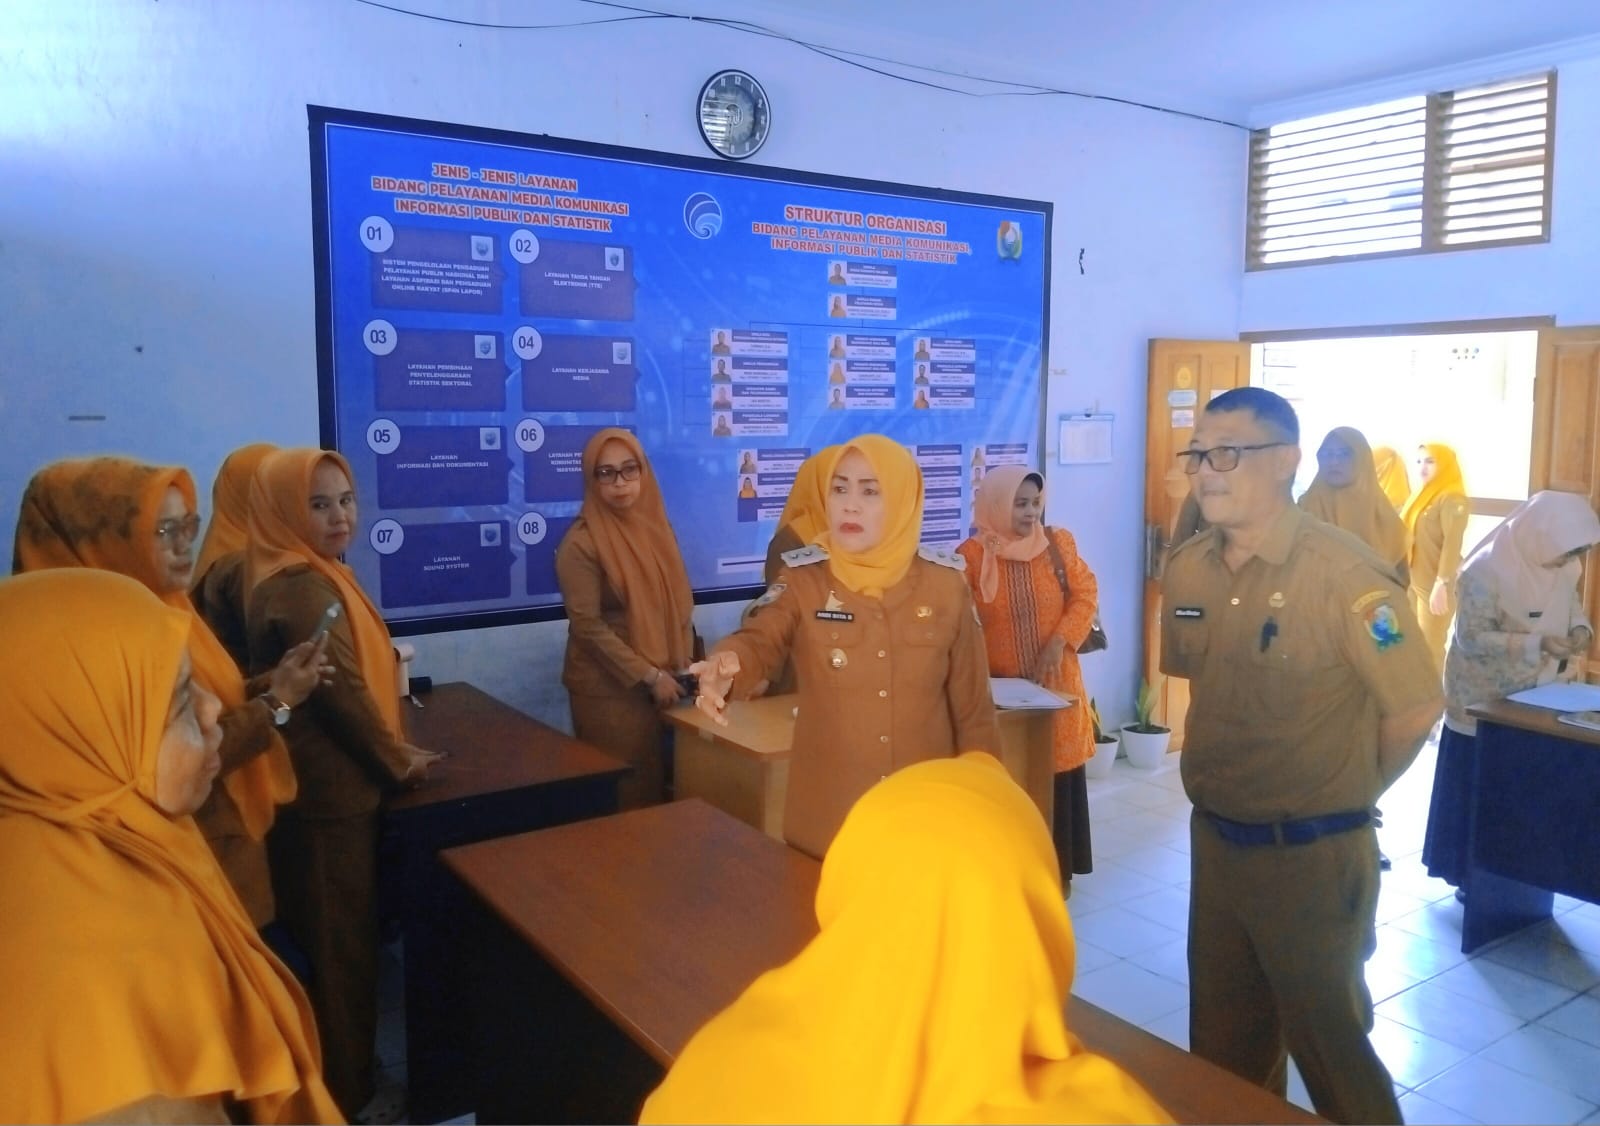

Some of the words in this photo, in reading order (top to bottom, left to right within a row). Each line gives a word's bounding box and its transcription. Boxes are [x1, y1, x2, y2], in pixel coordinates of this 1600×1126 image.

[432, 163, 469, 179] JENIS
[481, 169, 516, 185] JENIS
[519, 174, 577, 191] LAYANAN
[372, 177, 427, 193] BIDANG
[429, 182, 508, 202] PELAYANAN
[511, 190, 552, 207] MEDIA
[555, 196, 629, 216] KOMUNIKASI
[395, 199, 470, 217] INFORMASI
[474, 206, 519, 222] PUBLIK
[523, 211, 550, 225] DAN
[552, 214, 612, 232] STATISTIK
[785, 205, 863, 227] STRUKTUR
[867, 214, 947, 236] ORGANISASI
[366, 226, 382, 241] 01
[752, 223, 798, 238] BIDANG
[801, 228, 867, 244] PELAYANAN
[870, 233, 903, 247] MEDIA
[515, 239, 532, 253] 02
[771, 238, 835, 255] INFORMASI
[839, 244, 880, 258] PUBLIK
[882, 248, 903, 260] DAN
[905, 250, 958, 265] STATISTIK
[370, 330, 387, 344] 03
[518, 336, 535, 349] 04
[373, 429, 391, 443] 05
[520, 428, 537, 441] 06
[523, 521, 539, 535] 08
[377, 530, 394, 543] 07
